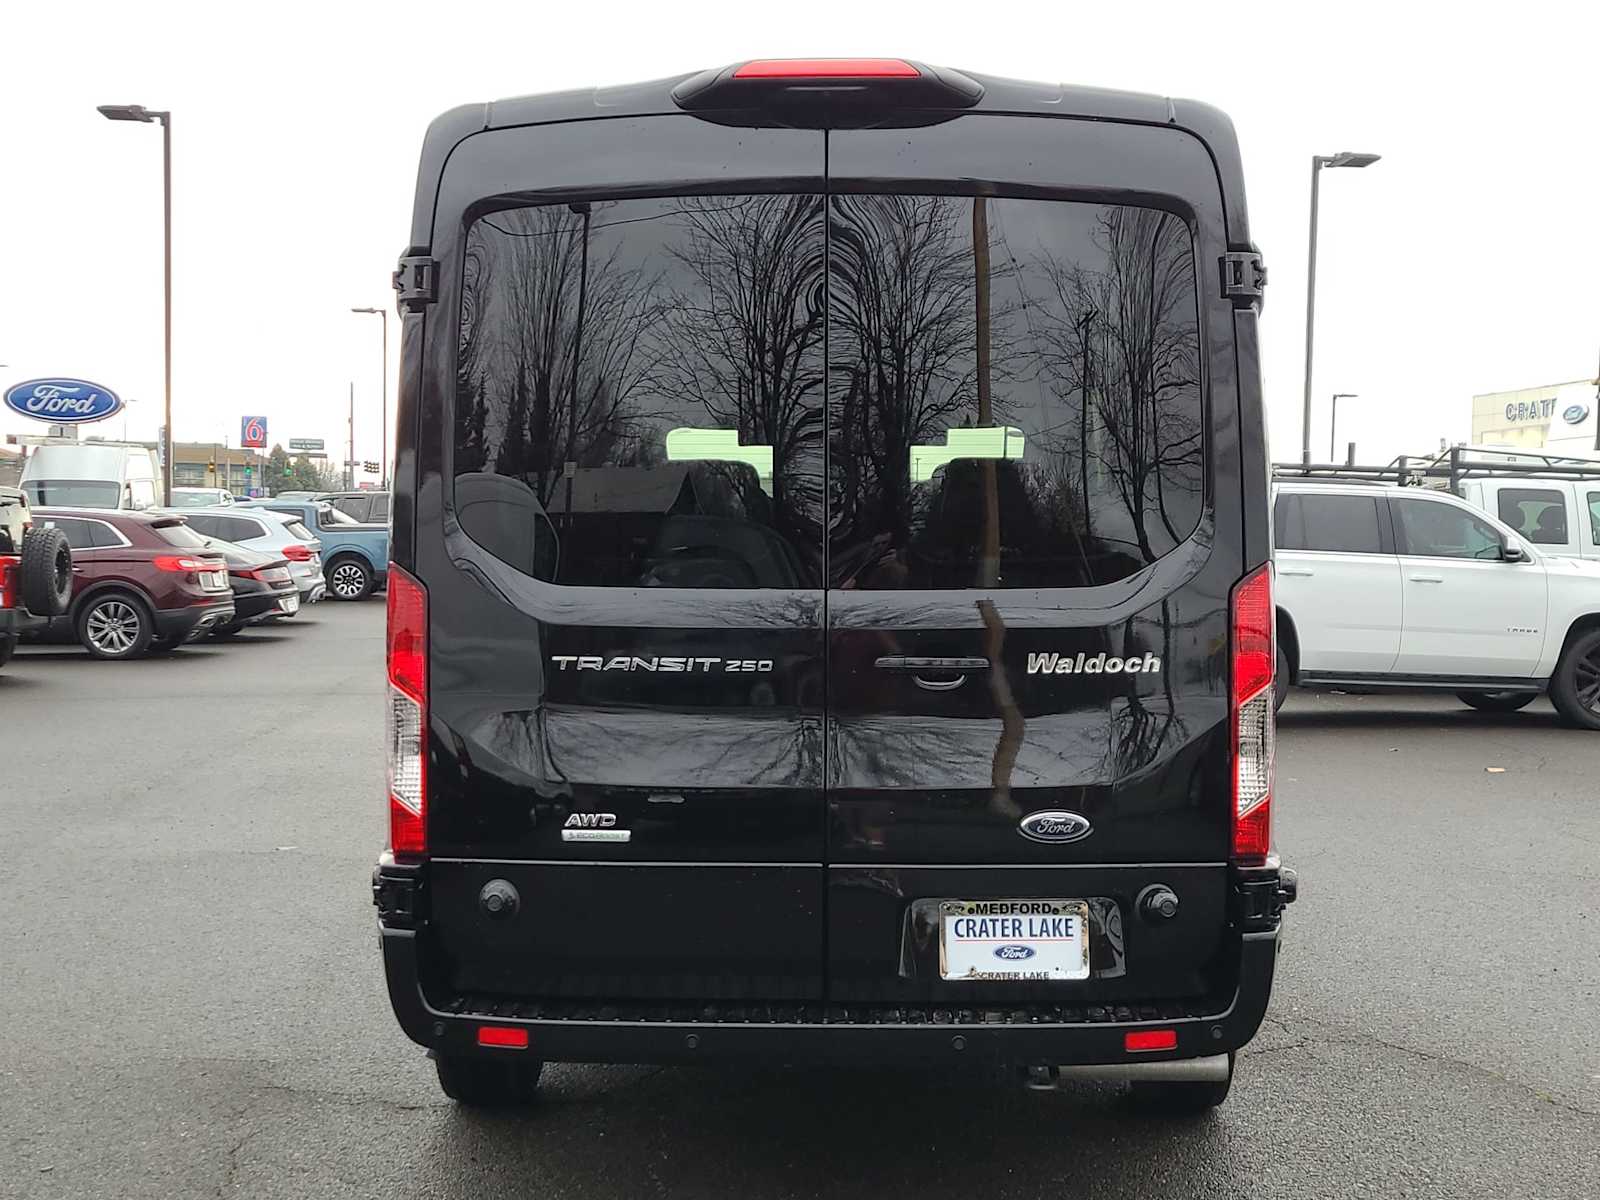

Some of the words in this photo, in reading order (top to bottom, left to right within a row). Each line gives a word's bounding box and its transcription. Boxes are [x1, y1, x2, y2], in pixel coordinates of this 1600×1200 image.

[26, 384, 97, 413] Ford
[246, 417, 264, 442] 6
[551, 655, 722, 672] TRANSIT
[724, 659, 774, 672] 250
[1026, 652, 1162, 675] Waldoch
[564, 813, 617, 827] AWD
[1036, 817, 1075, 835] Ford
[975, 903, 1051, 915] MEDFORD
[954, 918, 1023, 938] CRATER
[1029, 918, 1074, 938] LAKE
[1001, 946, 1028, 958] Ford
[980, 971, 1020, 980] CRATER
[1023, 971, 1049, 980] LAKE
